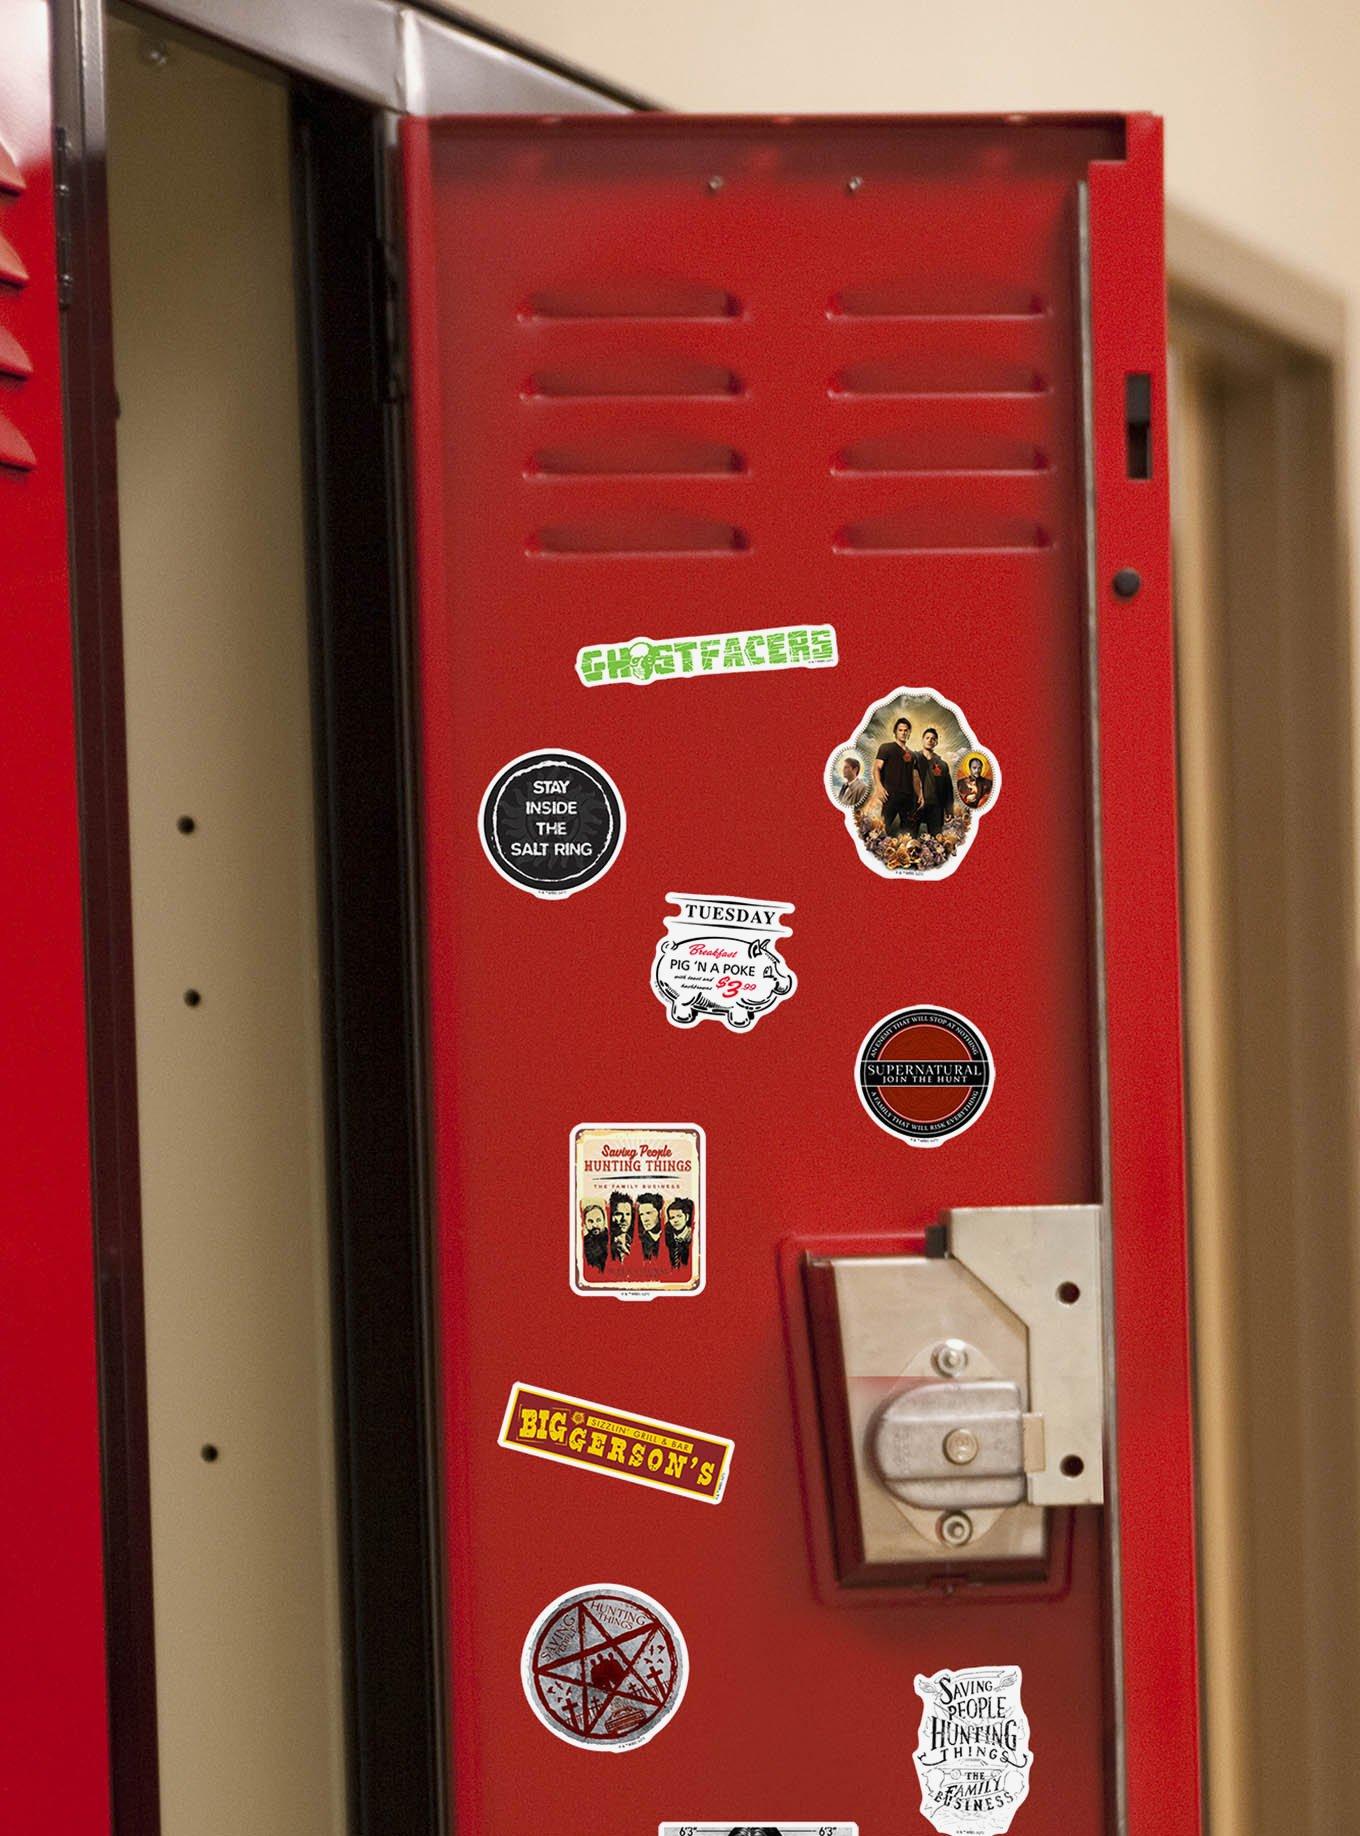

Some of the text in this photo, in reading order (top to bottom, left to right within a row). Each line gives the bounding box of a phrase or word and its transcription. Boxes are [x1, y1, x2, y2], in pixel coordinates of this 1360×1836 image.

[533, 780, 570, 794] STAY
[525, 801, 577, 815] INSIDE
[536, 822, 567, 835] THE
[511, 842, 592, 856] SALT RING
[685, 904, 776, 925] TUESDAY
[689, 944, 738, 959] Breakfast
[670, 959, 690, 971] PIG
[710, 963, 720, 974] A
[723, 963, 756, 977] POKE
[876, 1029, 893, 1048] ENEMY
[893, 1018, 911, 1030] THAT
[911, 1015, 928, 1023] WILL
[929, 1016, 948, 1025] STOP
[946, 1021, 956, 1029] AT
[955, 1027, 979, 1055] NOTHING
[867, 1064, 982, 1076] SUPERNATURAL
[882, 1076, 907, 1084] JOIN
[874, 1097, 891, 1118] FAMILY
[892, 1115, 910, 1128] THAT
[929, 1123, 946, 1131] RISK
[946, 1090, 979, 1126] EVERYTHING
[601, 1144, 673, 1160] Saving People
[584, 1160, 692, 1172] HUNTING THINGS
[633, 1430, 658, 1443] GRILL
[661, 1438, 668, 1446] &
[671, 1440, 689, 1451] BAR
[590, 1601, 647, 1626] HUNTING
[598, 1612, 634, 1630] THINGS
[541, 1614, 576, 1662] SAVING
[938, 1676, 993, 1705] SAVING
[948, 1696, 1007, 1721] PEOPLE
[931, 1715, 1017, 1751] HUNTING
[938, 1746, 1011, 1765] THINGS
[966, 1771, 985, 1780] THE
[946, 1776, 1002, 1798] FAMILY
[934, 1790, 1014, 1811] BUSINESS
